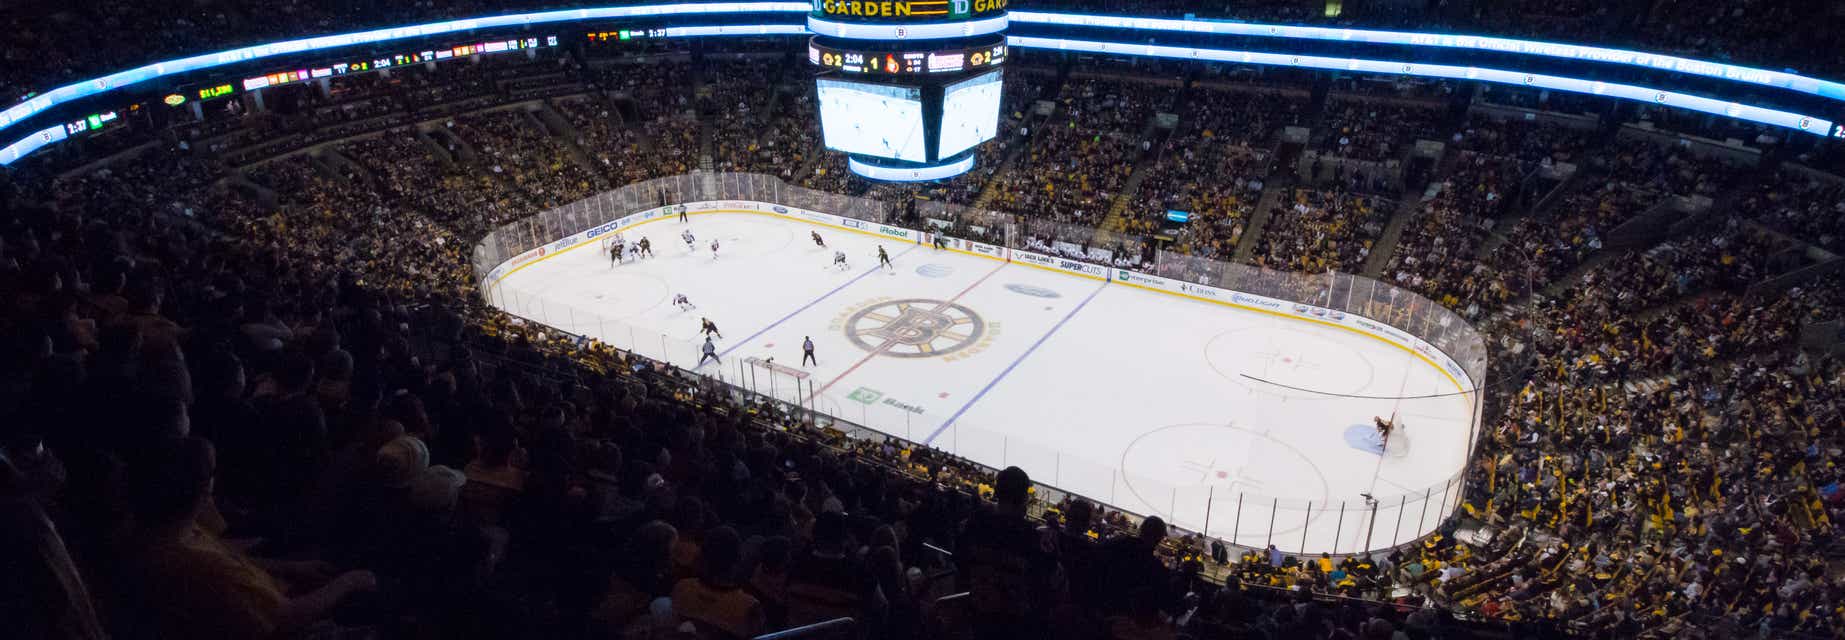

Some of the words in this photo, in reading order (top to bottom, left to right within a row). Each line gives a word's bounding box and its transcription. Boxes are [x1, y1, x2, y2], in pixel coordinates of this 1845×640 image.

[824, 0, 911, 16] GARDEN
[373, 58, 391, 69] 2:04
[834, 55, 842, 67] 2
[845, 53, 864, 65] 2:04
[870, 57, 878, 70] 1
[1652, 57, 1673, 69] the
[1676, 60, 1723, 77] Boston
[1726, 67, 1771, 84] Bruins
[586, 221, 618, 239] GEICO
[880, 225, 908, 238] iRobot
[1060, 260, 1101, 275] SUPERCUTS
[881, 398, 925, 415] Bank
